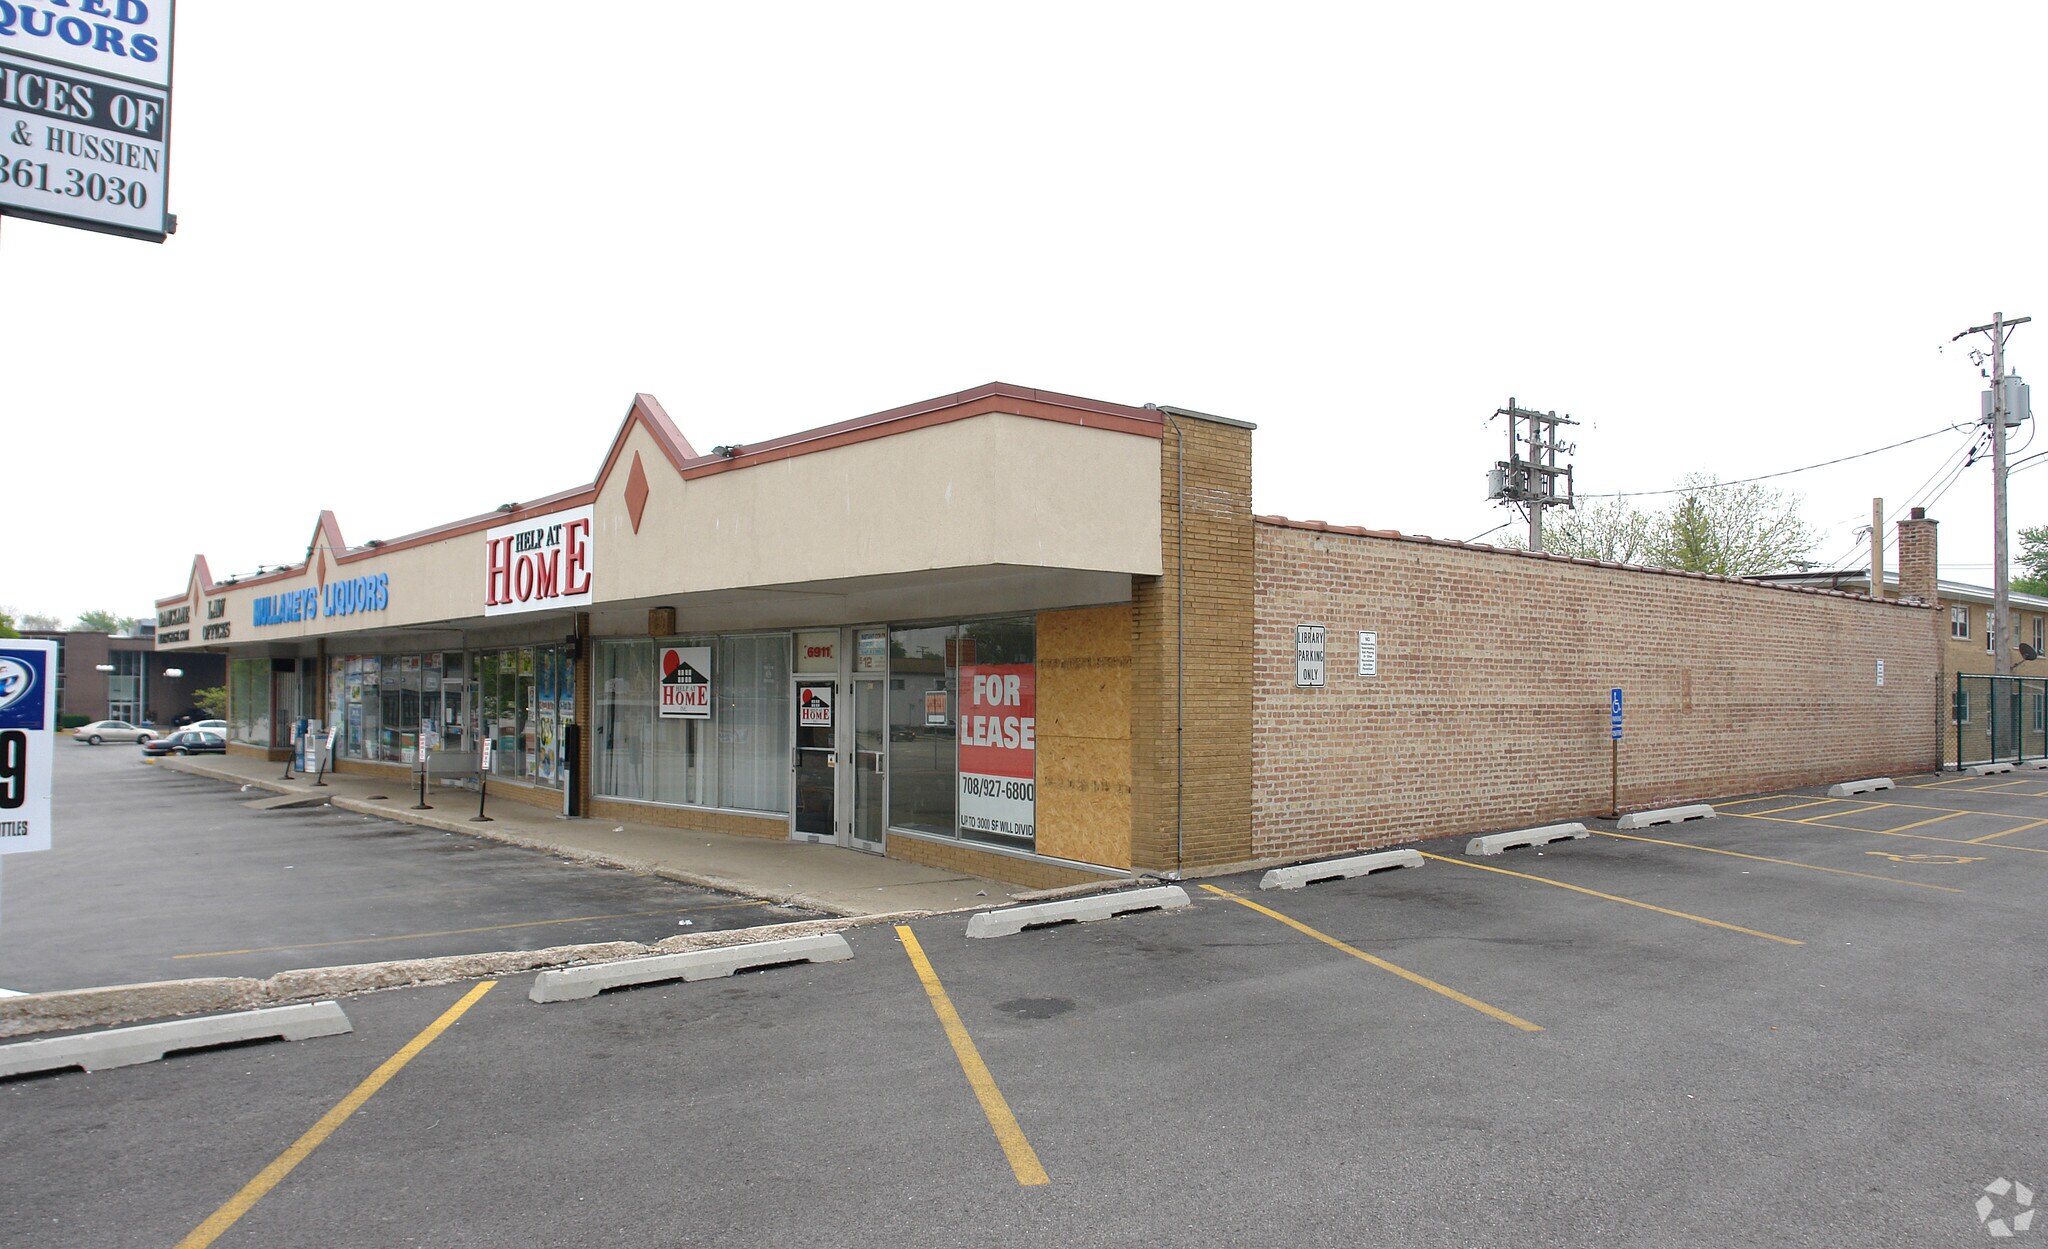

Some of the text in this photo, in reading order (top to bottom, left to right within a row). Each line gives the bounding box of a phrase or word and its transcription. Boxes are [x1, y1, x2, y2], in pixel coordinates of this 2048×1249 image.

[0, 69, 161, 133] ICES OF
[10, 120, 159, 173] & HUSSIEN
[515, 524, 562, 553] HELP AT
[484, 518, 591, 606] HOME
[253, 572, 389, 627] MULLANEYS LIQUORS
[1298, 632, 1323, 644] LIBRARY
[807, 646, 830, 658] 6911
[1298, 650, 1323, 662] PARKING
[1303, 669, 1318, 681] ONLY
[662, 685, 708, 706] HOME
[973, 674, 1020, 706] FOR
[802, 709, 829, 720] HOME
[961, 715, 1035, 750] LEASE
[962, 776, 1034, 802] 708/927-6800
[961, 815, 968, 825] UP
[969, 816, 975, 827] TO
[991, 819, 999, 831] SF
[1000, 820, 1013, 833] WILL
